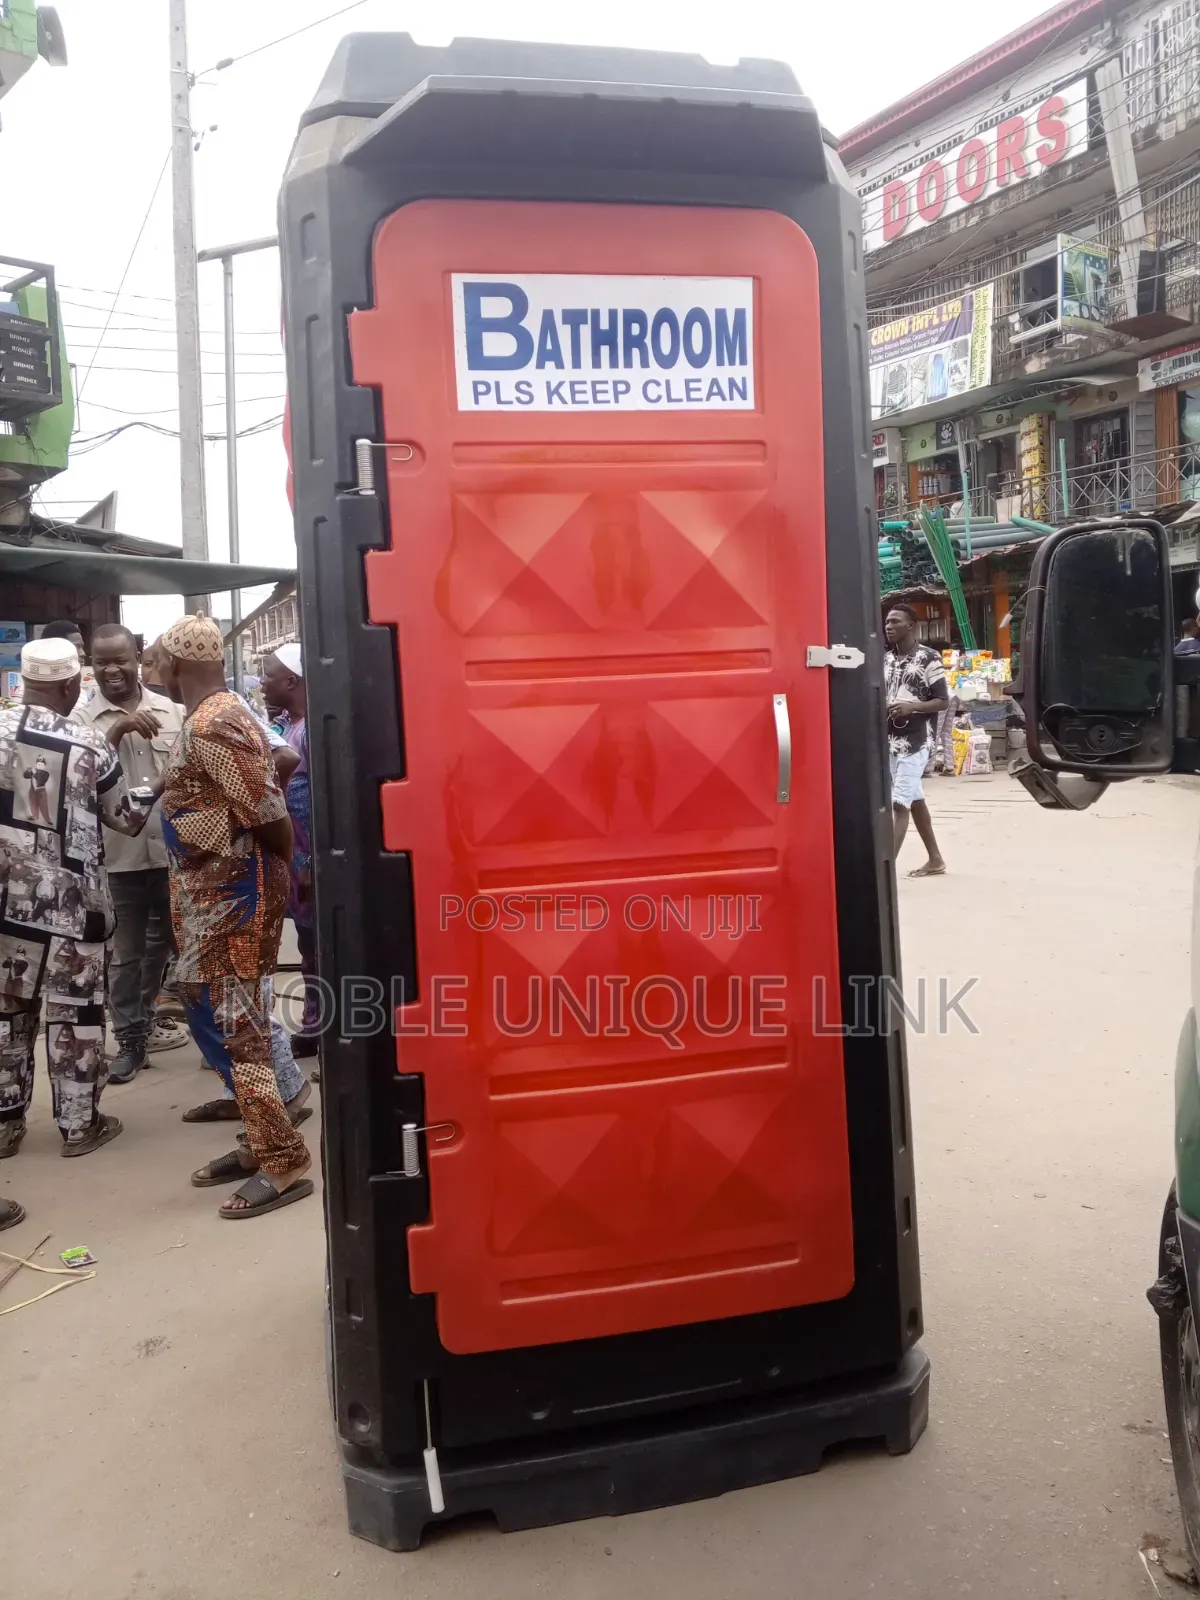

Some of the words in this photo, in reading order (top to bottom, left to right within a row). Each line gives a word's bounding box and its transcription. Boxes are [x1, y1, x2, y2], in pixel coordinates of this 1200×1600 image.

[882, 95, 1068, 242] DOORS
[463, 281, 748, 371] BATHROOM
[871, 318, 909, 346] CROWN
[980, 323, 988, 335] Opp
[10, 333, 31, 344] BRIMIX
[12, 345, 33, 356] BRIMIX
[13, 361, 35, 370] BRIMIX
[16, 376, 38, 384] BRIMIX
[472, 380, 535, 405] PLS
[545, 380, 631, 405] KEEP
[642, 376, 748, 403] CLEAN
